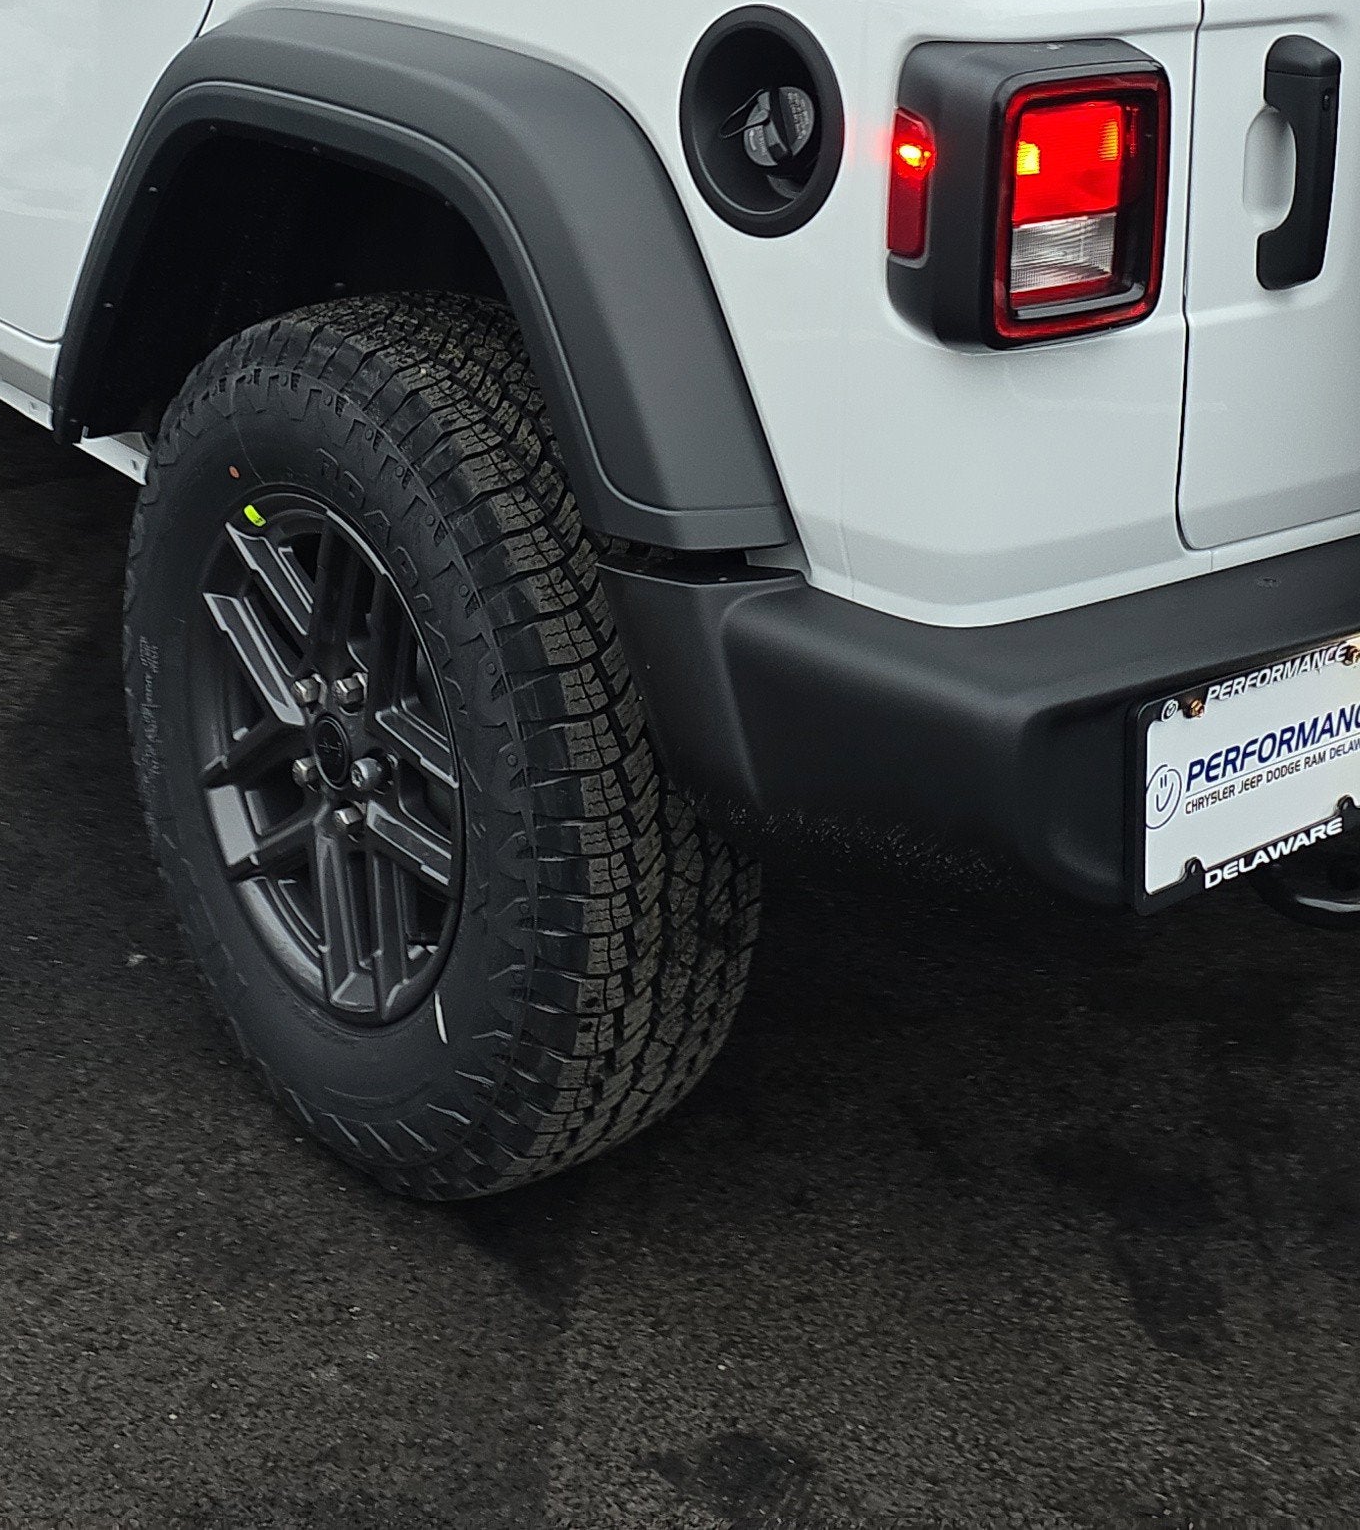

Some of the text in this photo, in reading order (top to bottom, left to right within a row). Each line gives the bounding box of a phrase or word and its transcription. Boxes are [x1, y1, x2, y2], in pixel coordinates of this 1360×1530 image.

[1204, 642, 1350, 706] PERFORMANCE
[1185, 783, 1236, 815] CHRYSLER
[1237, 773, 1263, 795] JEEP
[1265, 761, 1301, 784] DODGE
[1303, 749, 1327, 771] RAM
[1204, 817, 1343, 889] DELAWARE
